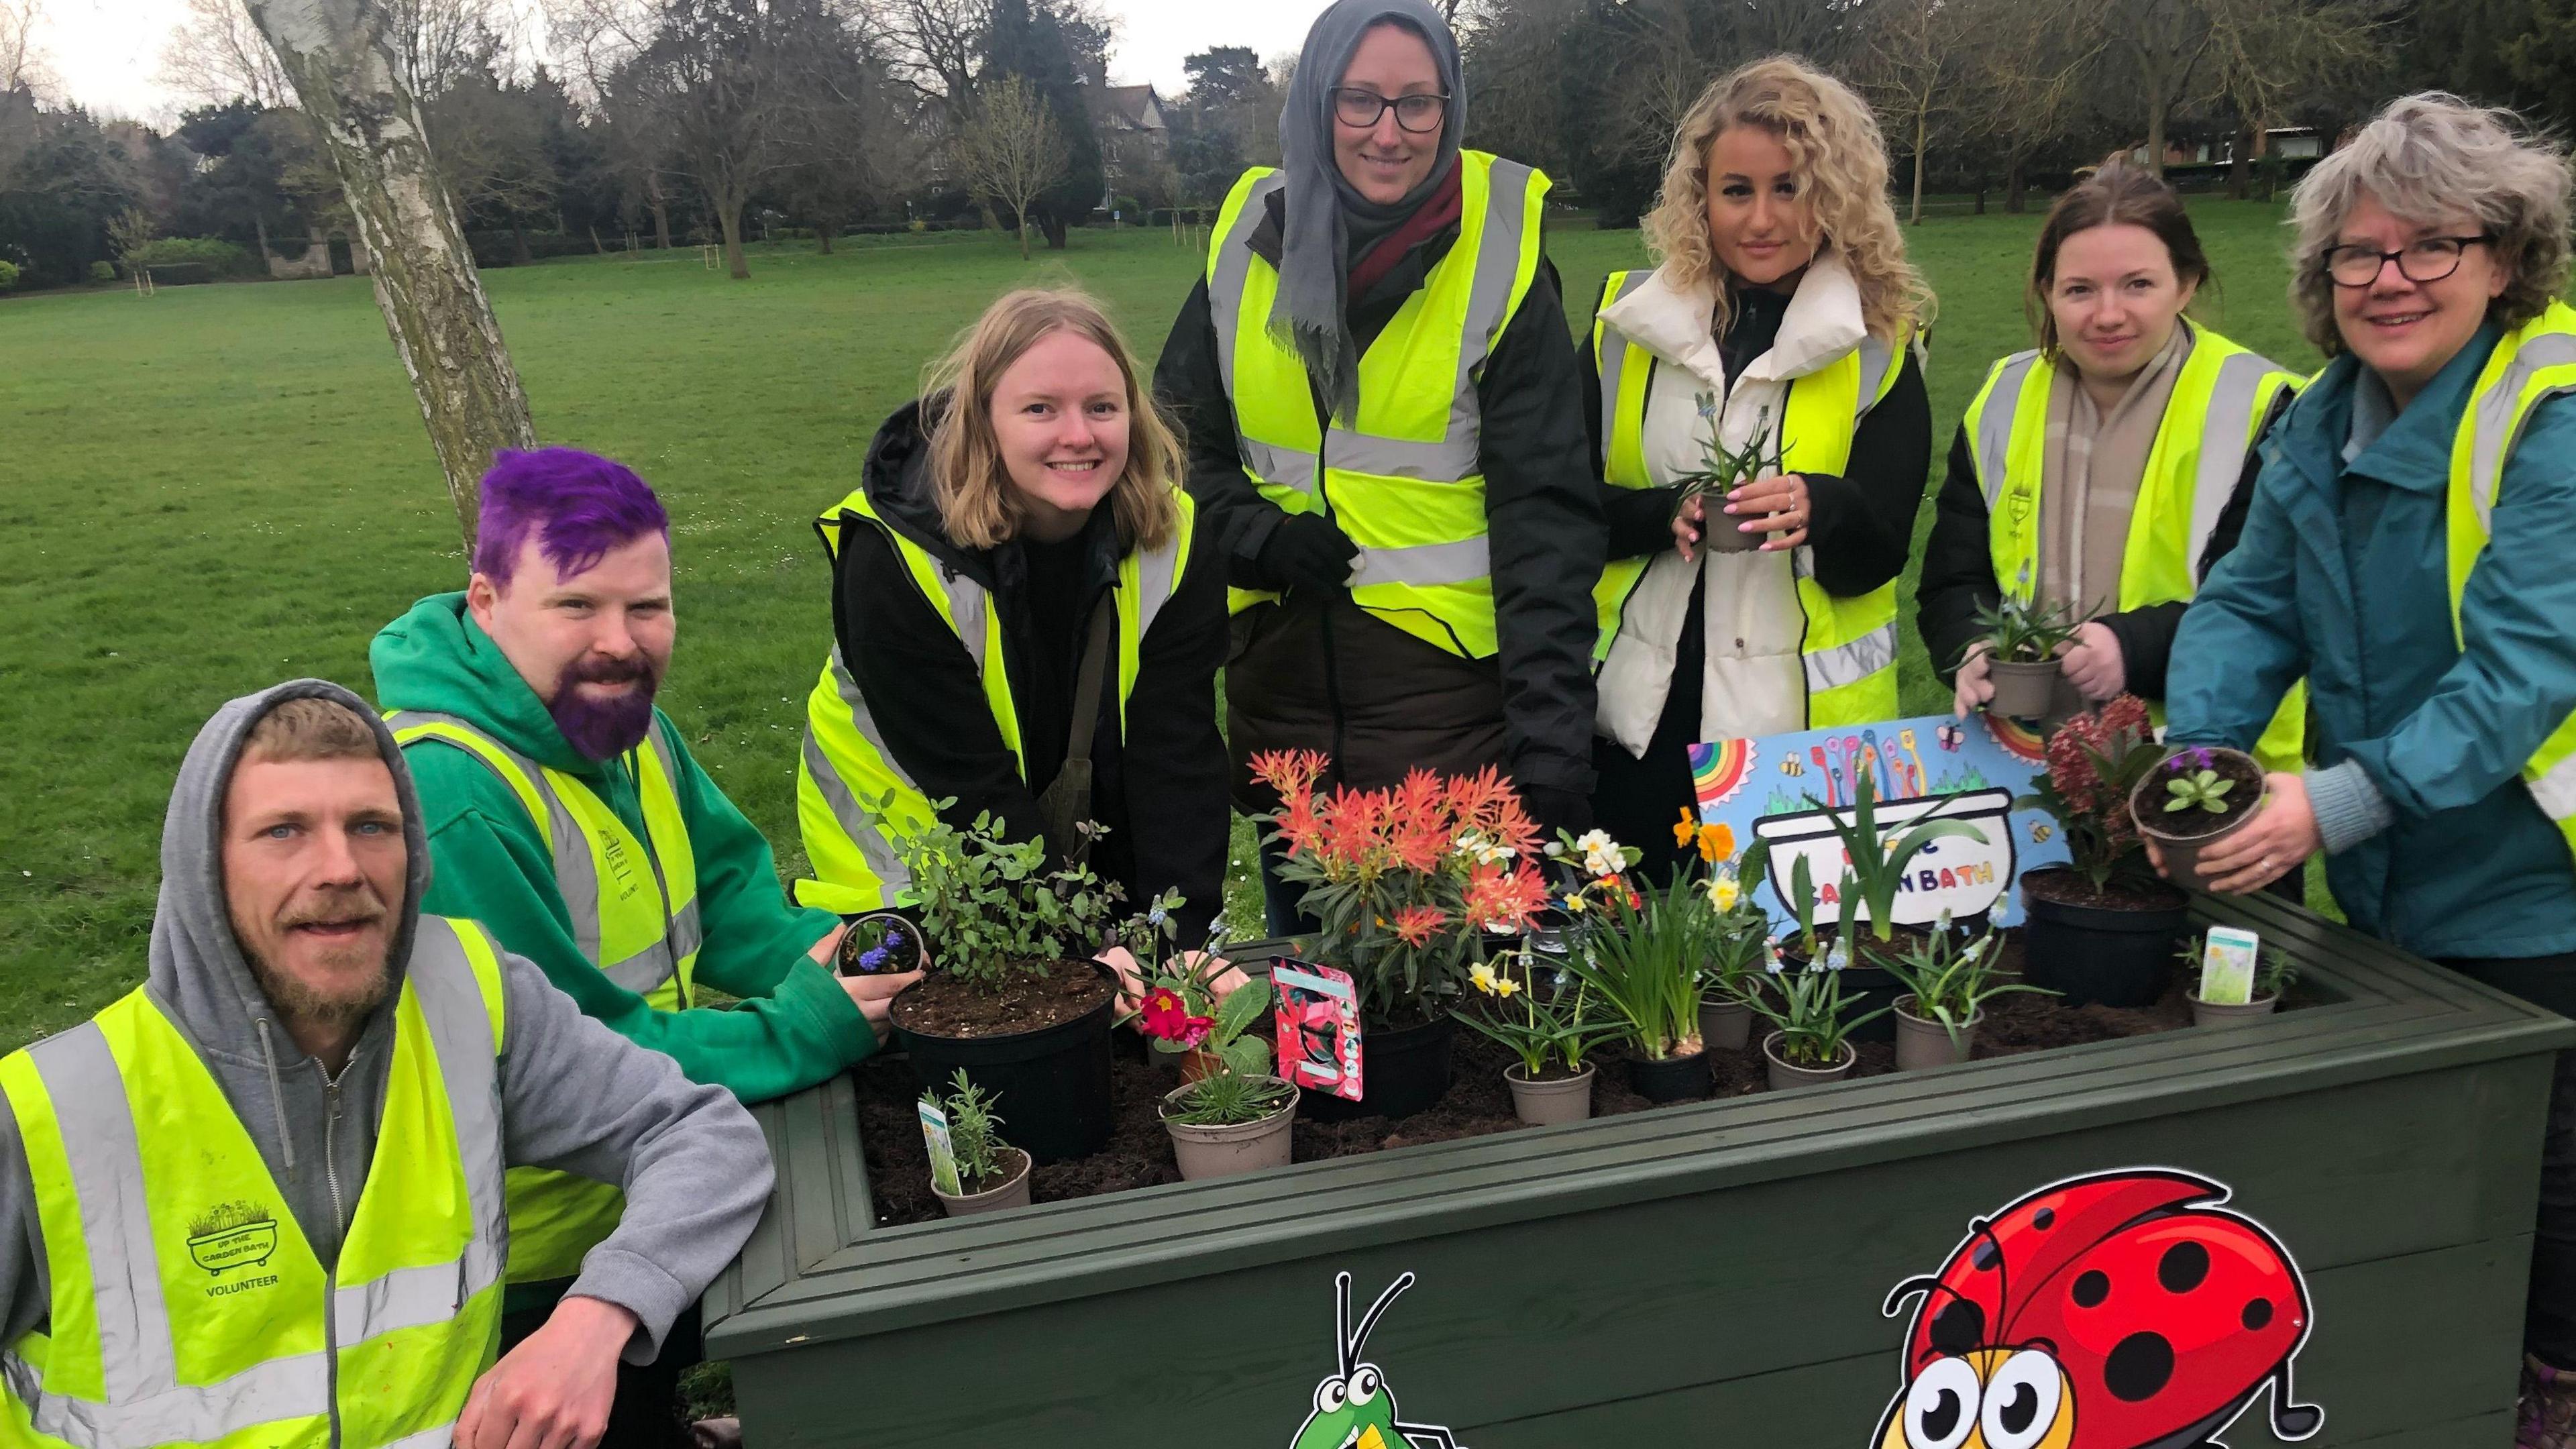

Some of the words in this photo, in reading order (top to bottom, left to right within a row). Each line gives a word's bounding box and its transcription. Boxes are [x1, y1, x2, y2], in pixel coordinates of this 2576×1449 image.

[1919, 861, 1994, 891] BATH
[217, 1240, 230, 1248] UP
[231, 1234, 251, 1244] THE
[243, 1242, 269, 1252] BATH
[206, 1275, 278, 1297] VOLUNTEER
